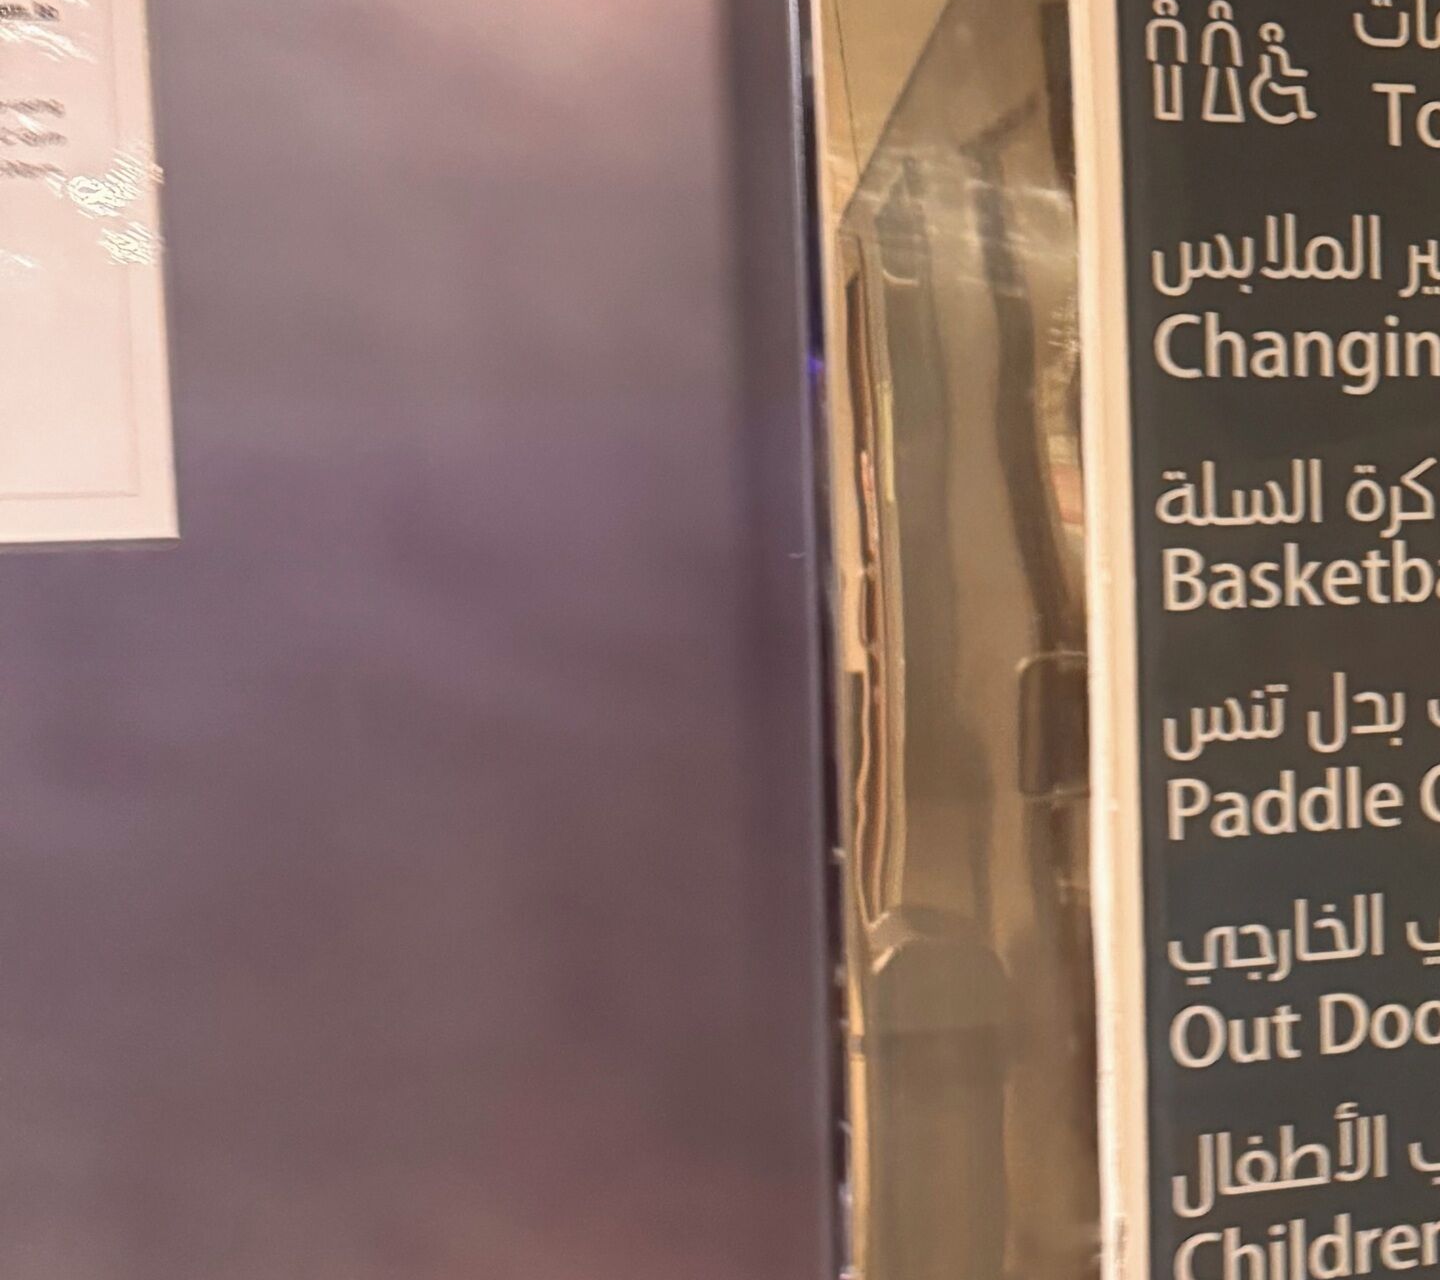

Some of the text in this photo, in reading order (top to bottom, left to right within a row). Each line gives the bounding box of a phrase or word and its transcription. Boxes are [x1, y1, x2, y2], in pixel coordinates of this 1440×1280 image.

[1152, 213, 1382, 297] الملابس
[1155, 459, 1323, 527] السلة
[1345, 457, 1438, 539] كرة
[1163, 683, 1289, 761] تنس
[1306, 671, 1405, 754] بدل
[1166, 765, 1404, 841] Paddle
[1168, 892, 1385, 984] الخارجي
[1169, 1005, 1302, 1068] Out
[1172, 1101, 1388, 1218] الأطفال
